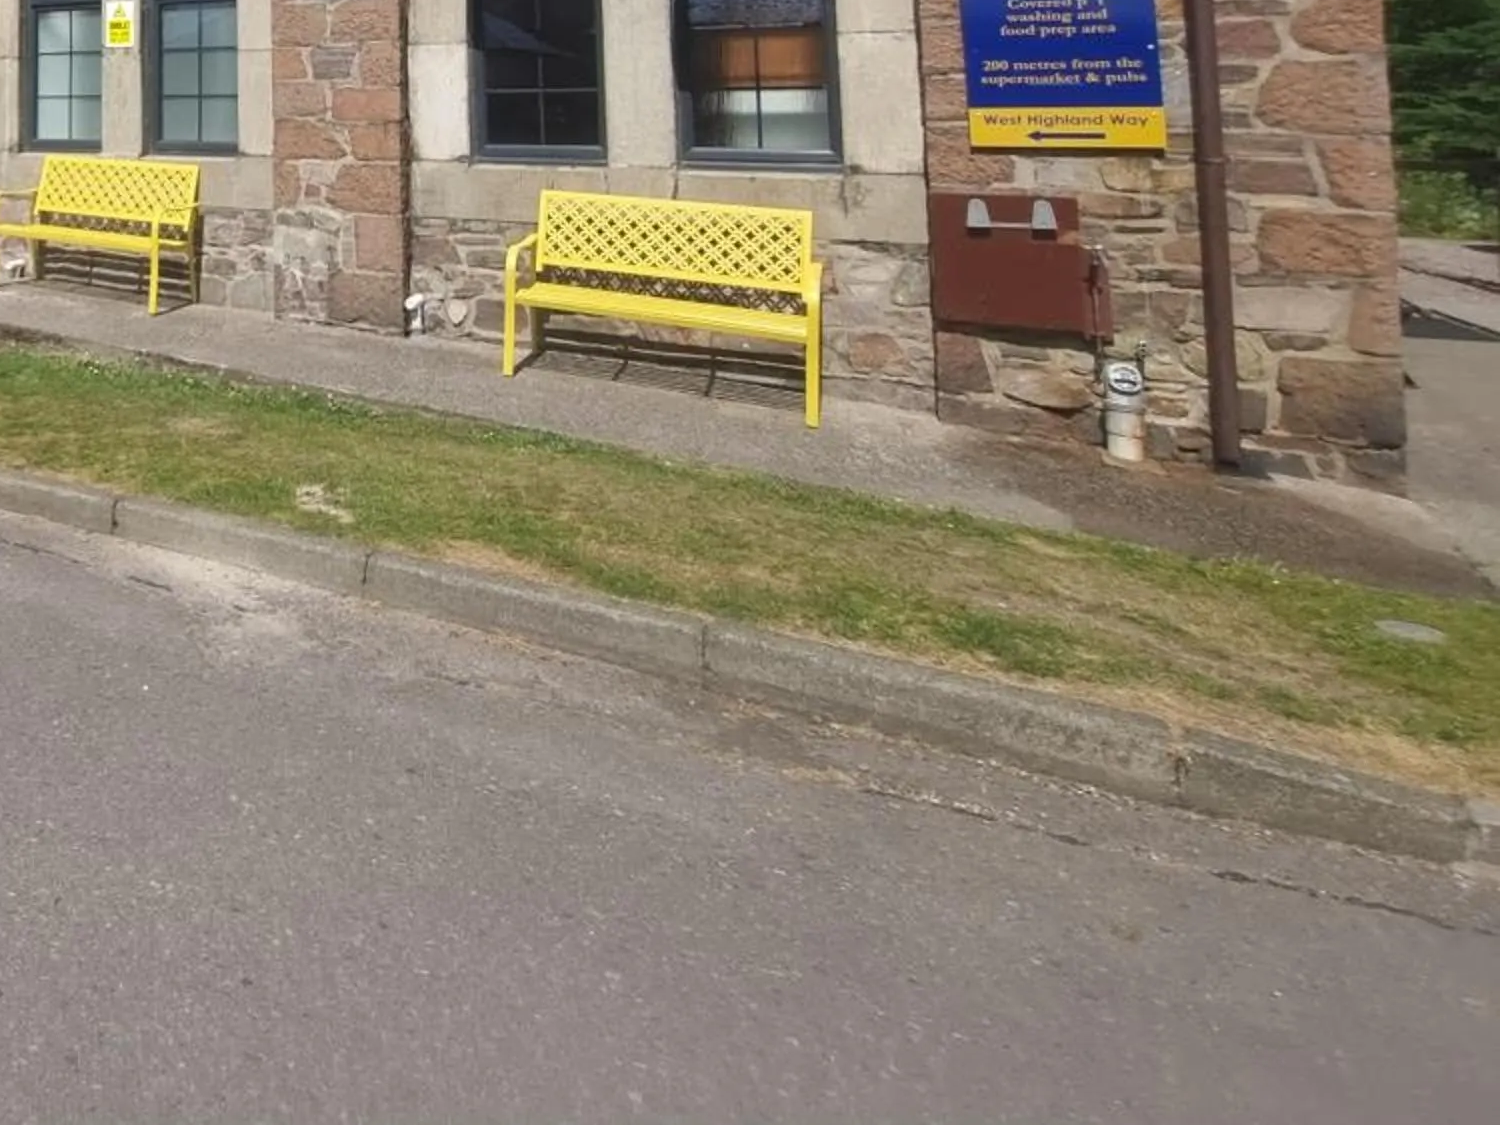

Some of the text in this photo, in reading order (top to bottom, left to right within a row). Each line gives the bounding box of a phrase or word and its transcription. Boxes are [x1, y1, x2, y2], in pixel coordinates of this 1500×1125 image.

[1006, 8, 1107, 23] washing and
[1000, 24, 1116, 38] food prep area
[983, 56, 1143, 72] 200 metres from the
[981, 73, 1081, 87] supermarket
[1085, 72, 1100, 84] &
[983, 114, 1149, 128] West Highland Way
